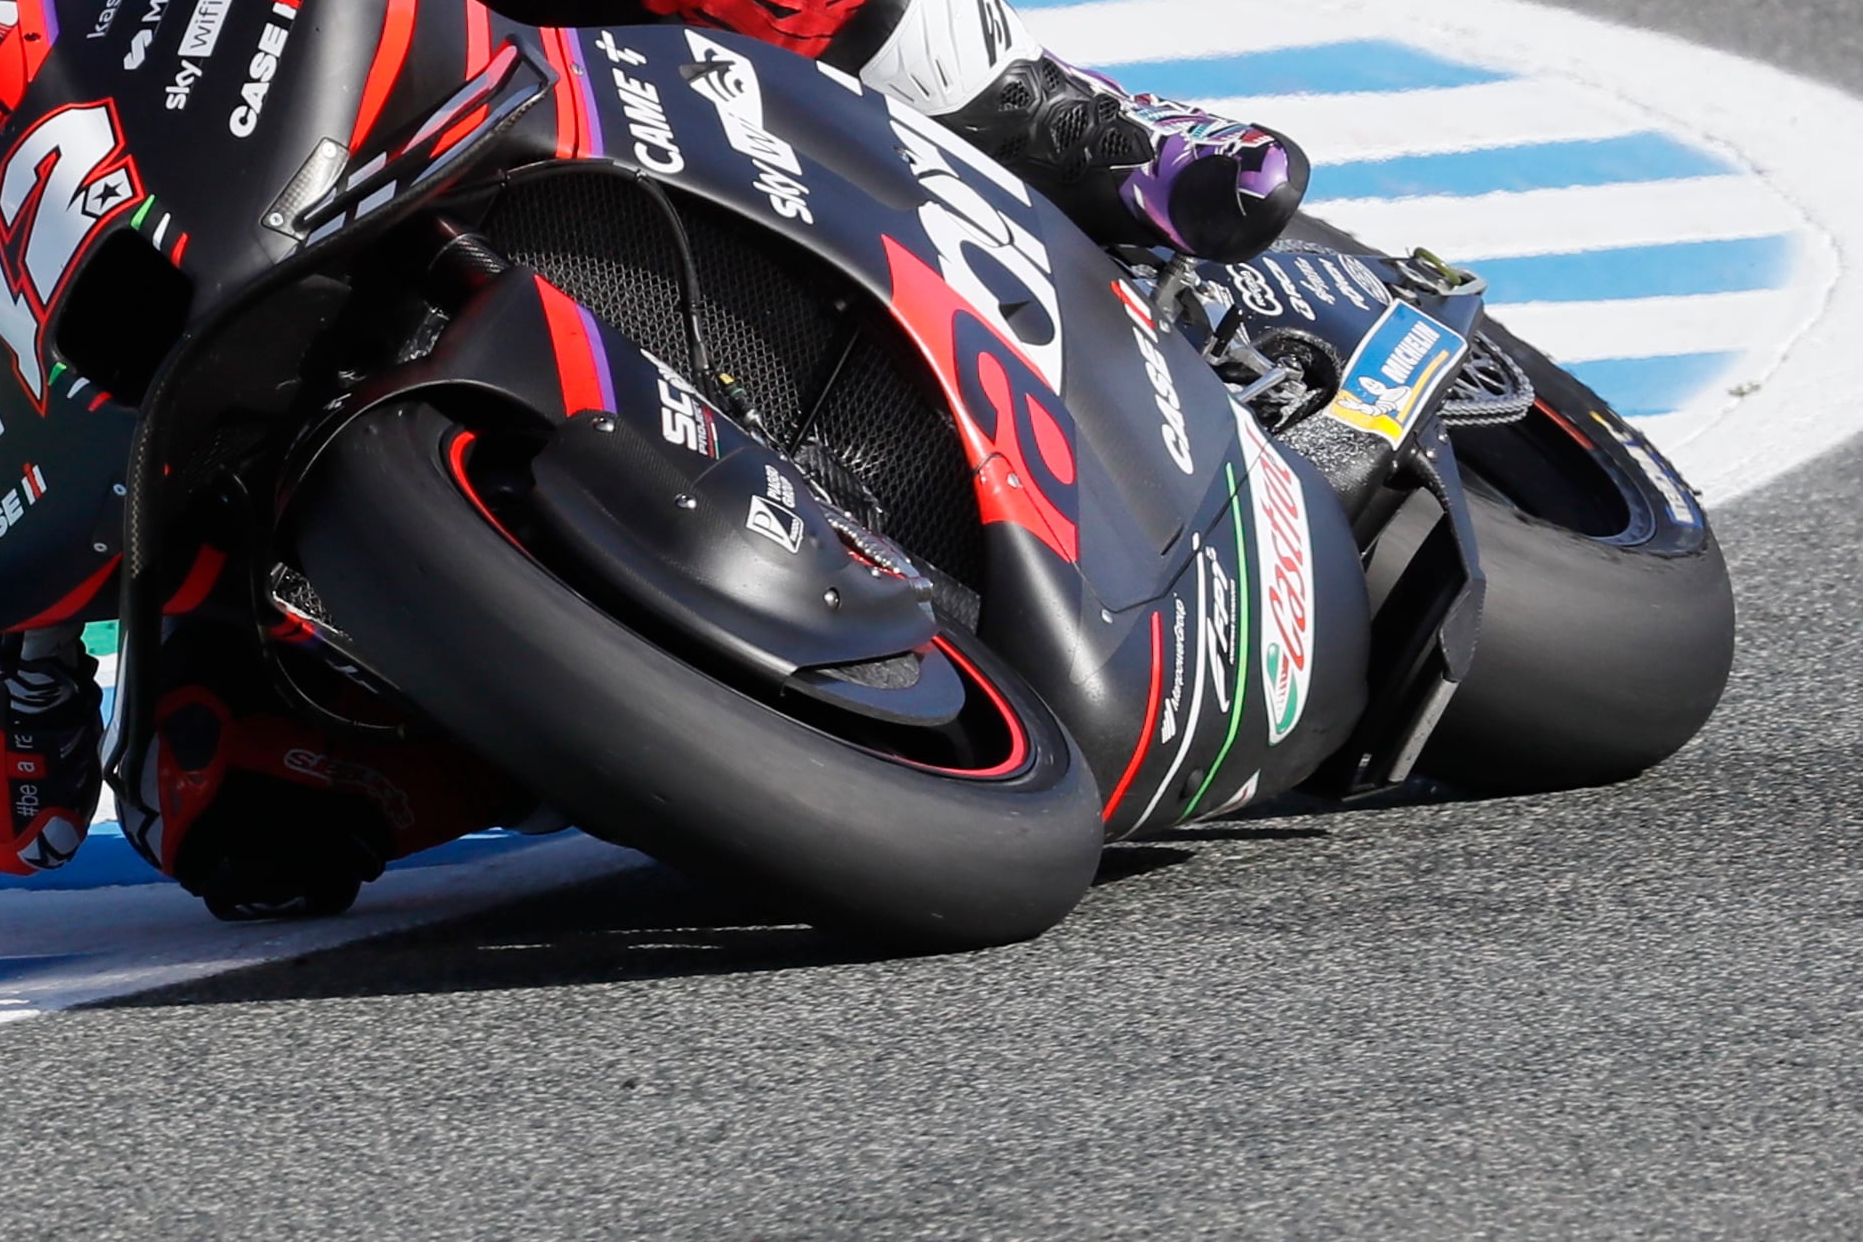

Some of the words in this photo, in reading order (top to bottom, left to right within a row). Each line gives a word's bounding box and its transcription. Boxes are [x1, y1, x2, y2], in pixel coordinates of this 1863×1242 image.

[165, 59, 203, 110] sky
[189, 0, 224, 49] wifi
[229, 22, 289, 138] CASE
[612, 68, 685, 175] CAME
[752, 158, 814, 225] sky
[1380, 320, 1441, 386] MICHELIN
[691, 398, 709, 456] PROJECT
[1132, 326, 1194, 475] CASE
[765, 464, 782, 502] PIAGGIO
[778, 475, 796, 508] GROUP
[1244, 424, 1306, 672] Castrol
[1171, 596, 1186, 713] ManpowerGroup
[17, 760, 35, 773] a
